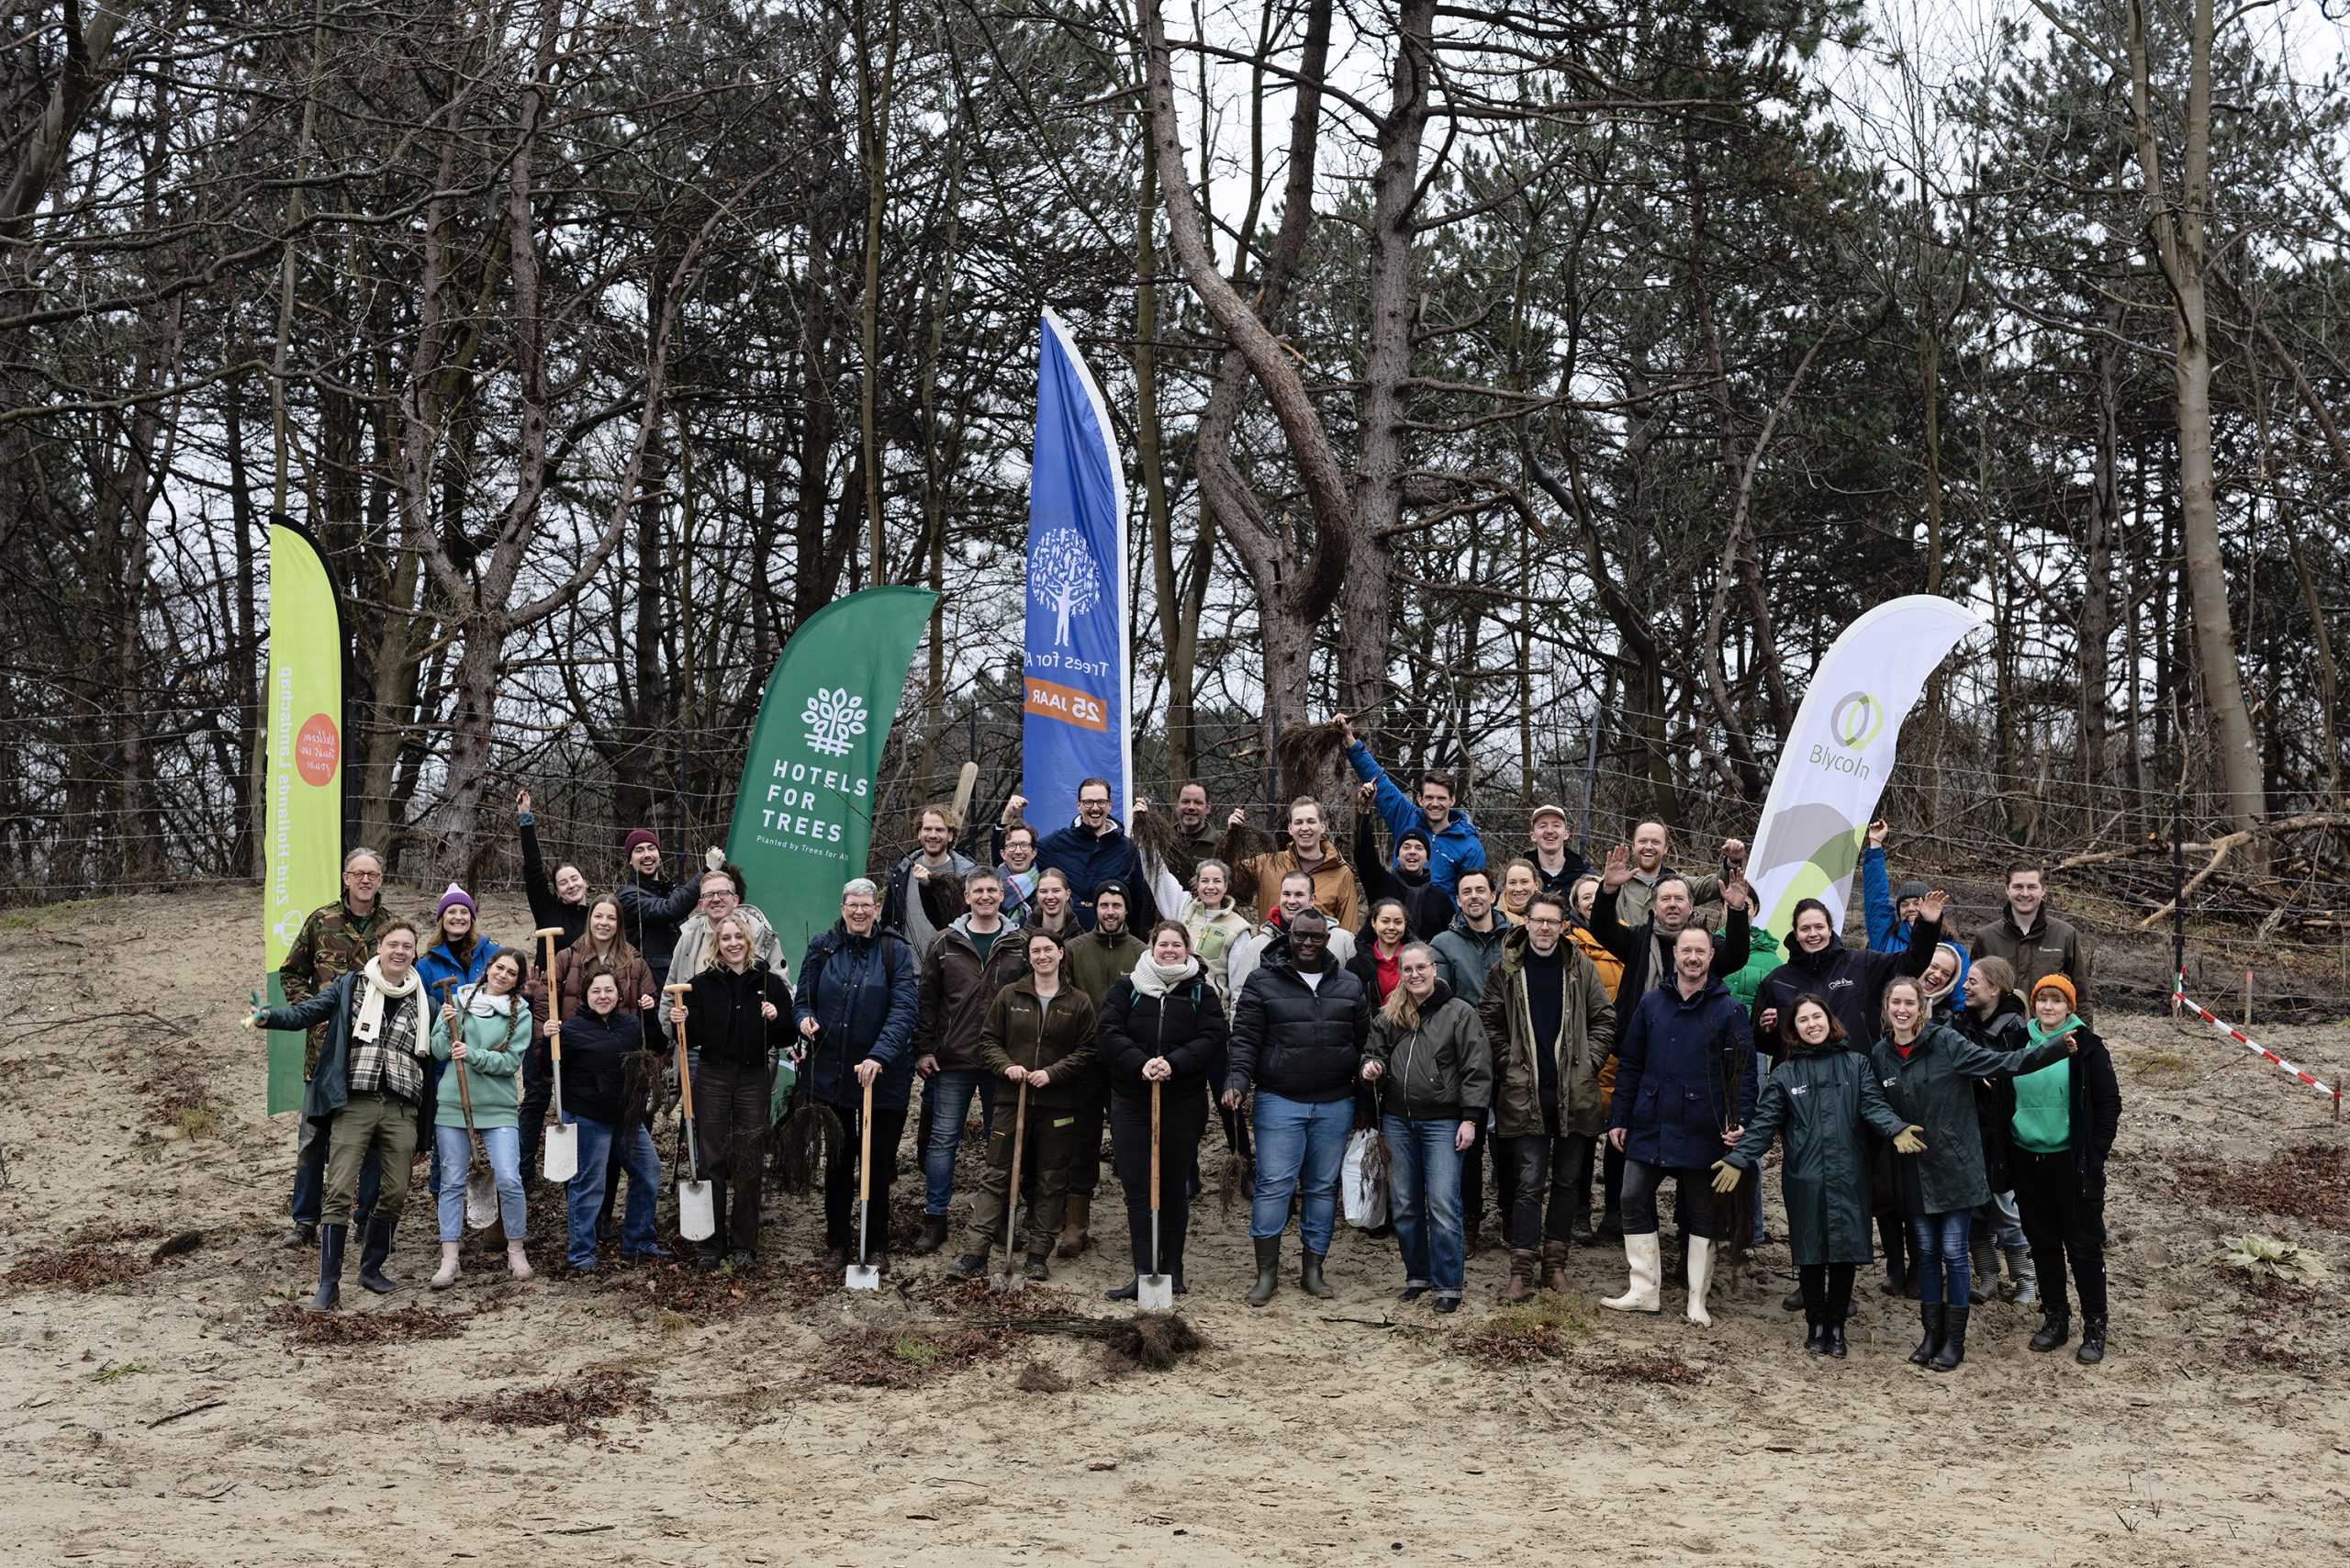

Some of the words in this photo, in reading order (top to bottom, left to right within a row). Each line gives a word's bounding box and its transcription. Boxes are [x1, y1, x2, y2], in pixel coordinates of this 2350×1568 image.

[773, 759, 868, 797] HOTELS
[767, 784, 815, 811] FOR
[763, 809, 842, 843] TREES
[756, 834, 788, 847] Planted
[789, 842, 799, 852] by
[801, 845, 823, 856] Trees
[825, 850, 837, 858] for
